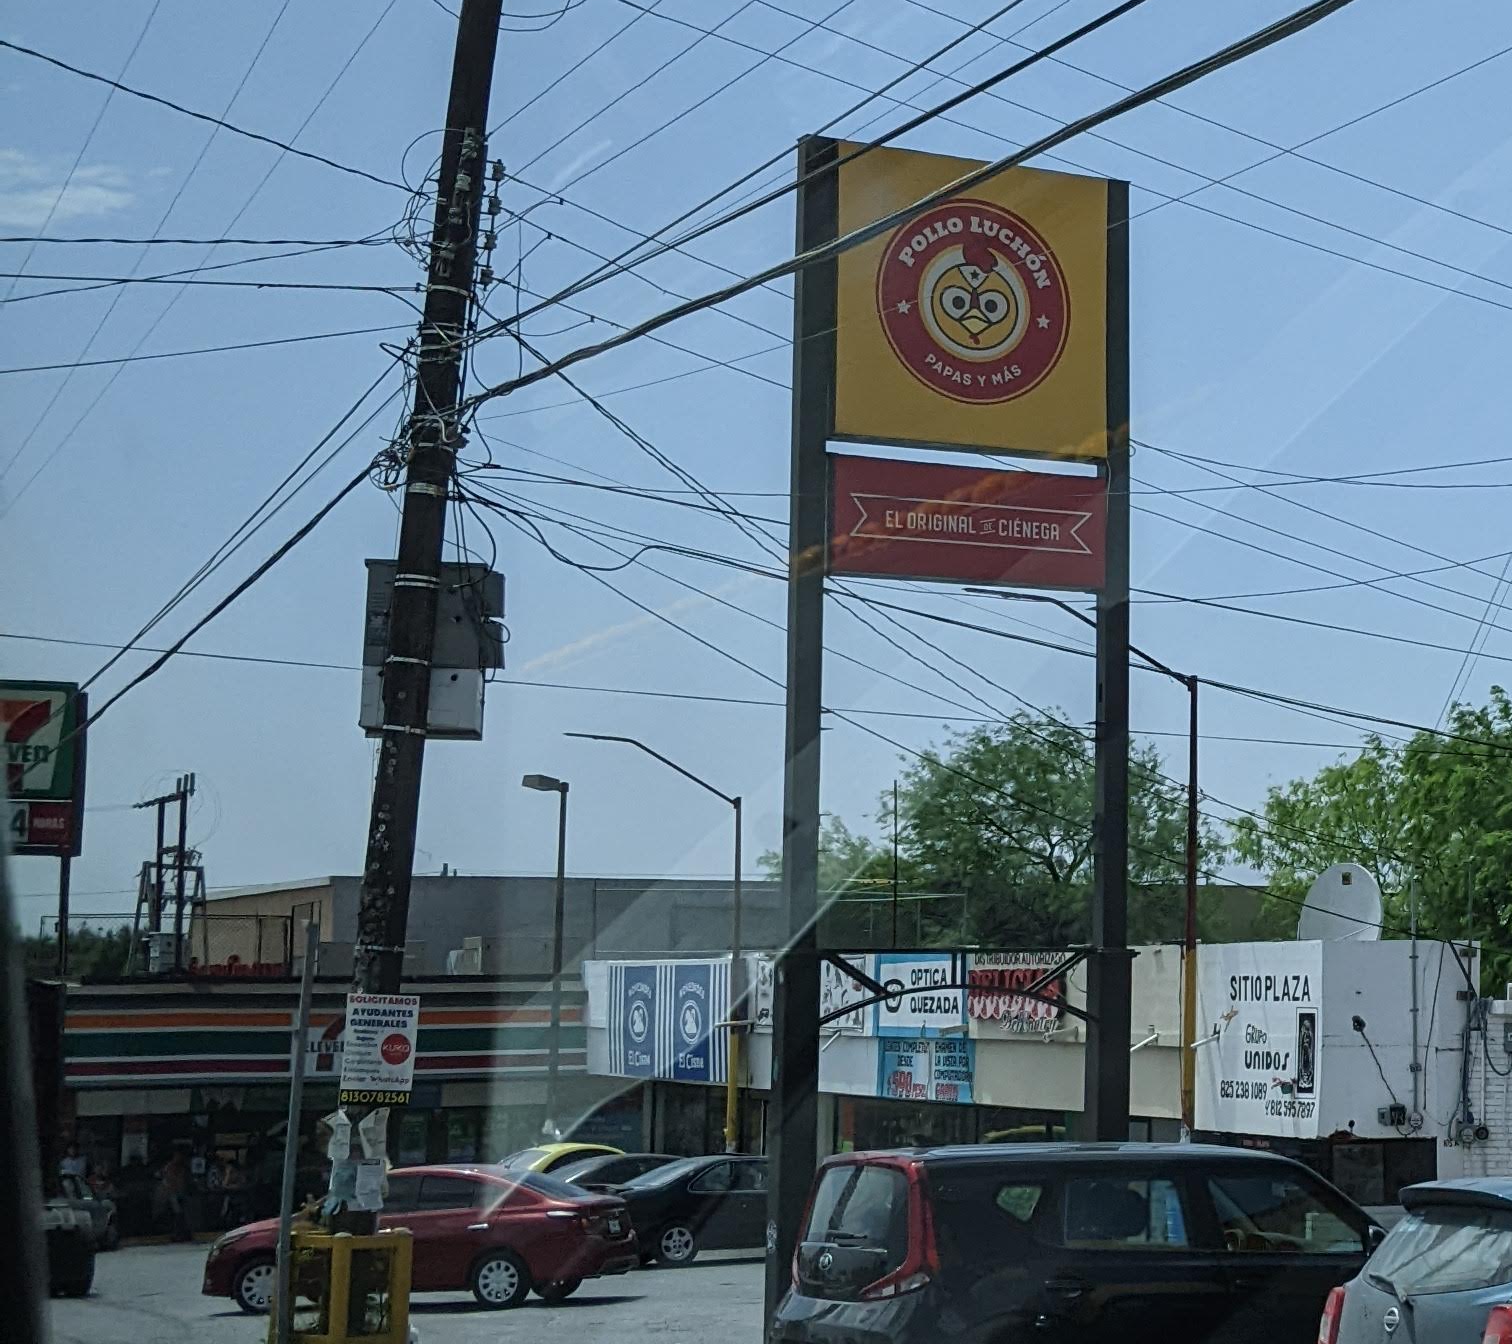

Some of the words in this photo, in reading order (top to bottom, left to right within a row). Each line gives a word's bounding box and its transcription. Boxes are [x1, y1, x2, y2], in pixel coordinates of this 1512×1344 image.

[898, 217, 963, 268] POLLO
[970, 216, 1051, 289] LUCHÓN
[925, 353, 972, 386] PAPAS
[977, 375, 987, 387] Y
[992, 364, 1022, 385] MÁS
[885, 510, 904, 529] EL
[907, 513, 977, 534] ORIGINAL
[983, 522, 993, 531] DE
[998, 518, 1061, 541] CIÉNEGA
[910, 968, 948, 986] OPTICA
[1230, 975, 1262, 1002] SITIO
[1264, 975, 1311, 1002] PLAZA
[350, 996, 418, 1006] SOLICITAMOS
[910, 997, 960, 1015] QUEZADA
[352, 1008, 414, 1018] AYUDANTES
[350, 1019, 408, 1028] GENERALES
[1244, 1050, 1290, 1071] UNIDOS
